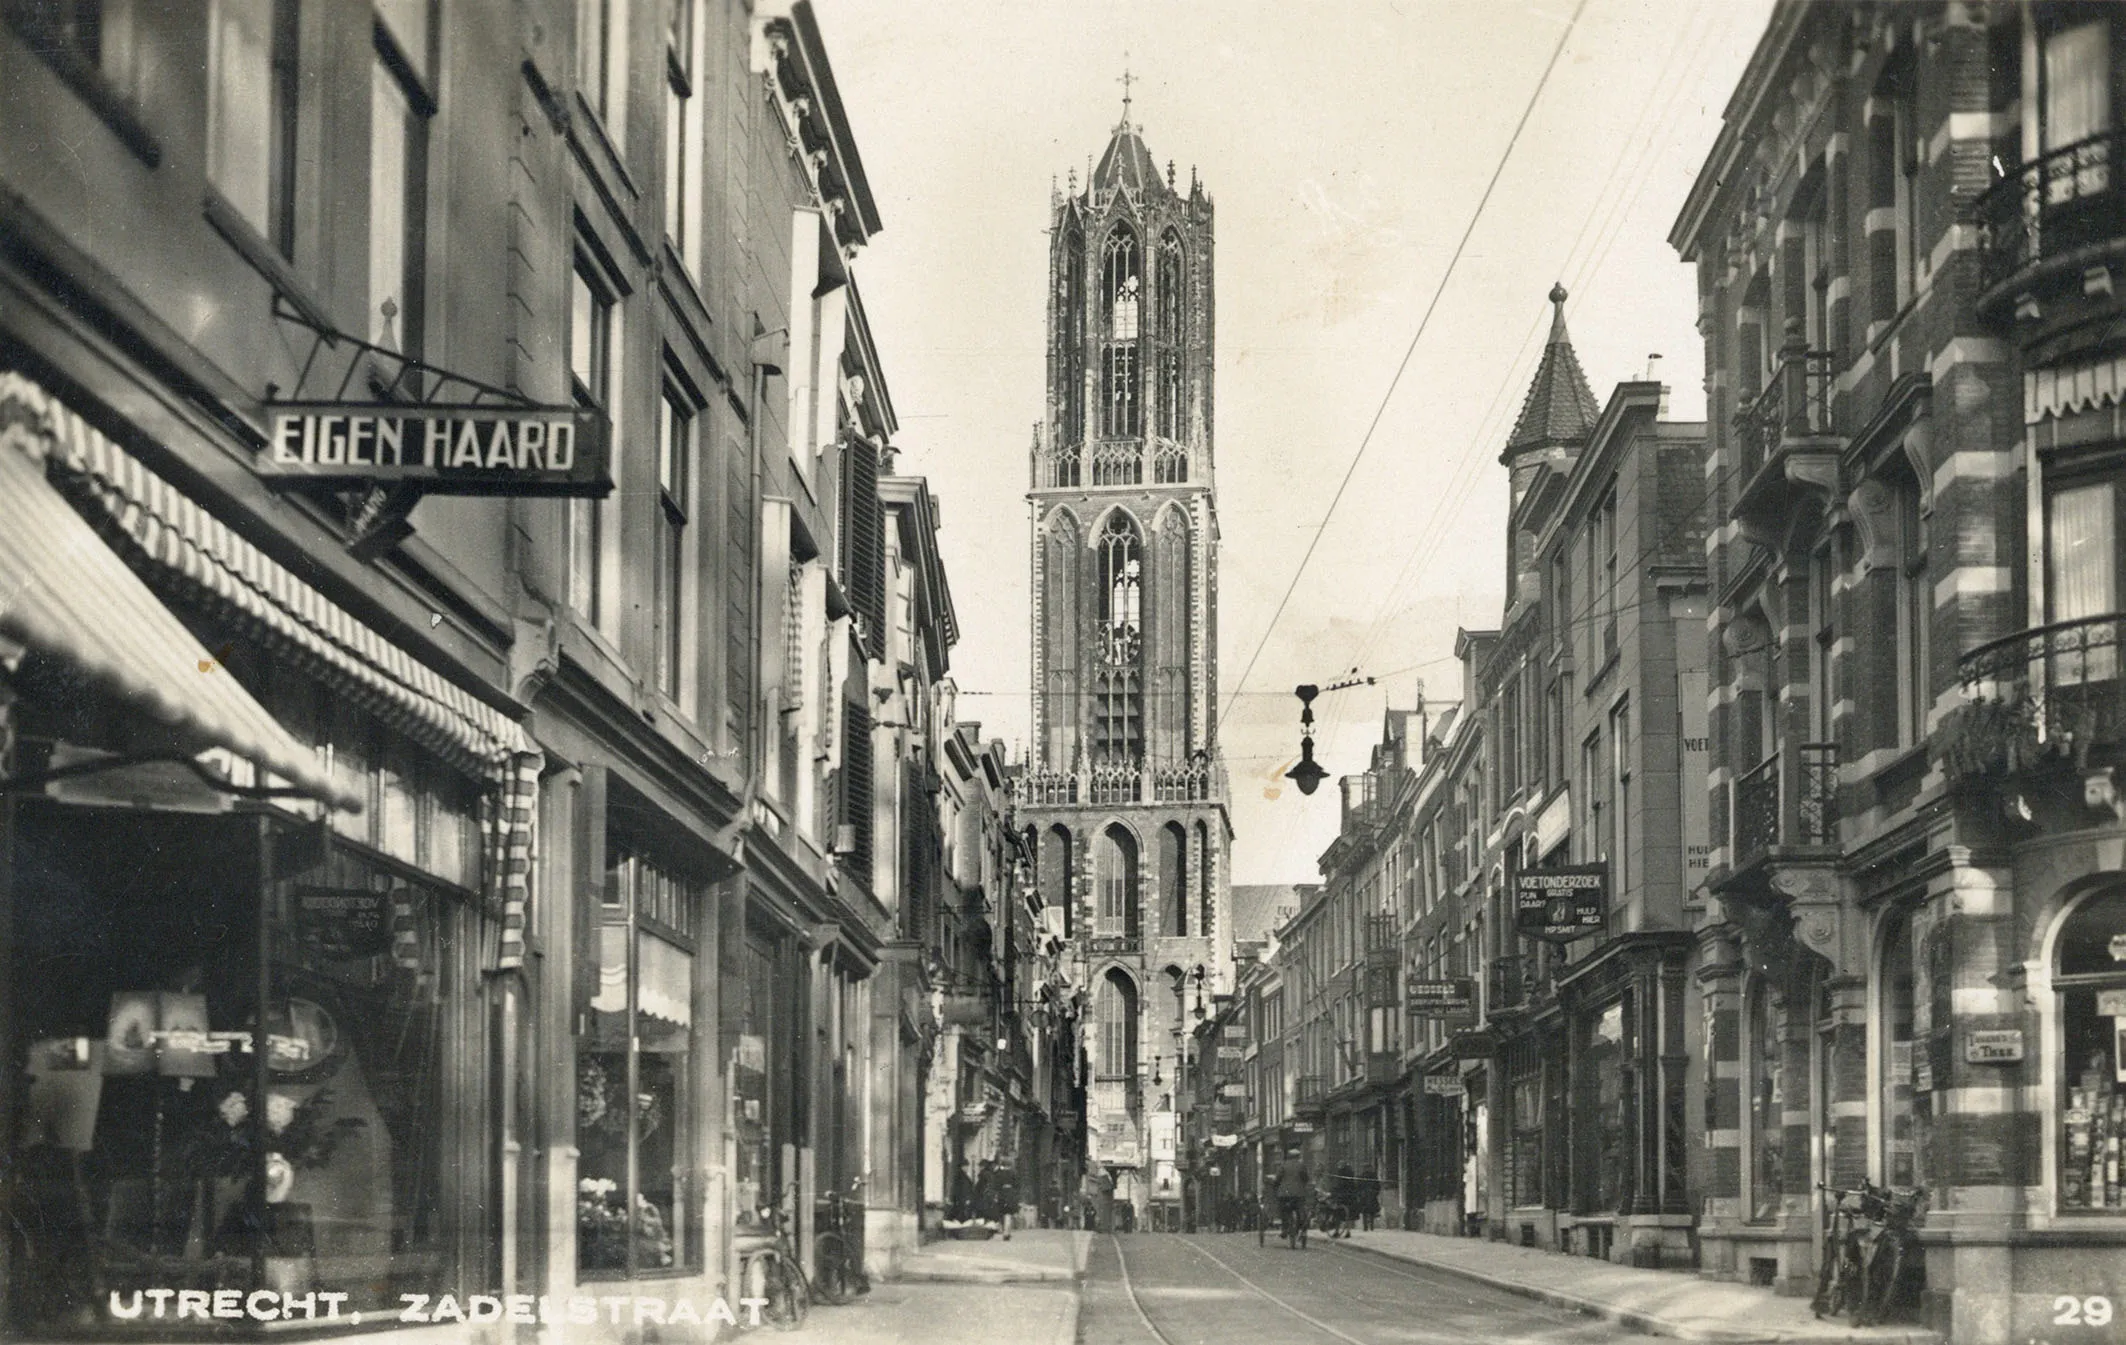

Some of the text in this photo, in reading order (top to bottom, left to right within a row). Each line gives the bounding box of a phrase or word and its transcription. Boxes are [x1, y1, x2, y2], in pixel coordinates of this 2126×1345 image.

[274, 415, 576, 470] EIGEN HAARD
[1519, 875, 1600, 889] VOETONDERZOEK
[1546, 888, 1574, 897] GRATIS
[1576, 907, 1597, 916] HULP
[1582, 915, 1601, 924] HIER
